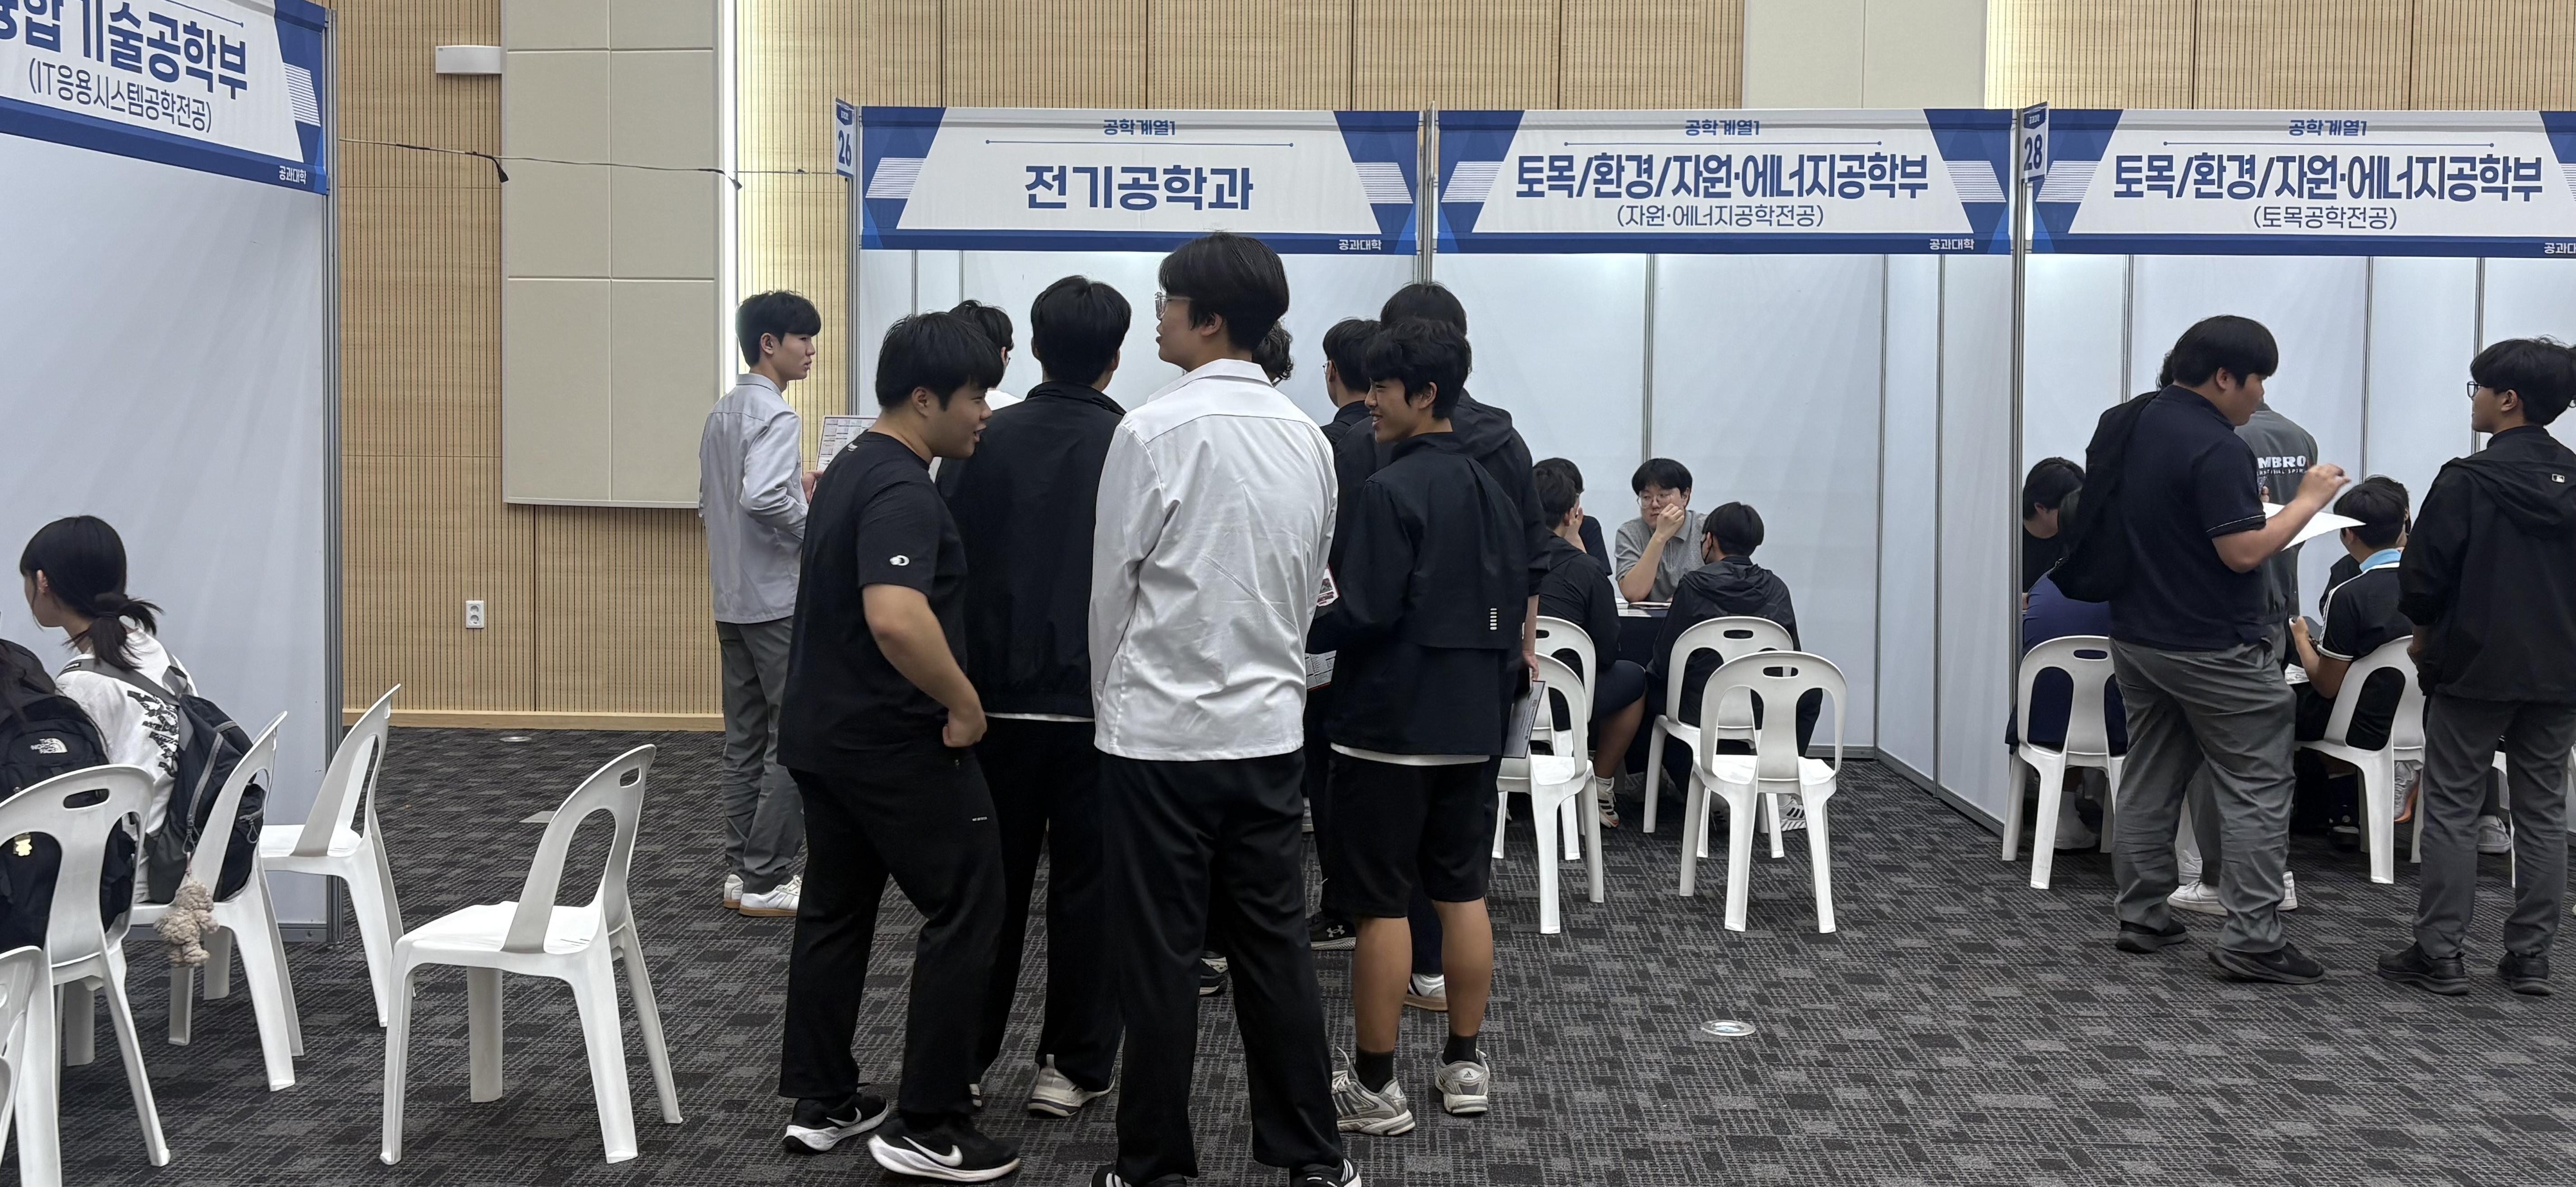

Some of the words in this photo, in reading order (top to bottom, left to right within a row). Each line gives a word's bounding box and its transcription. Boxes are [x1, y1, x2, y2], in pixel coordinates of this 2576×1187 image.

[29, 57, 211, 133] (IT응용시스템공학전공)
[1104, 119, 1175, 135] 공학계열1
[1685, 119, 1759, 136] 공학계열1
[2289, 119, 2367, 136] 공학계열1
[838, 130, 851, 167] 26
[2024, 134, 2042, 171] 28
[279, 166, 306, 184] 공과대학
[1025, 165, 1253, 211] 전기공학과
[1617, 204, 1823, 227] (자원·에너지공학전공)
[2254, 205, 2397, 230] (토목공학전공)
[1339, 239, 1382, 250] 공과대학
[1929, 238, 1974, 250] 공과대학
[2544, 243, 2576, 254] 공과대
[2257, 455, 2306, 469] MBRO
